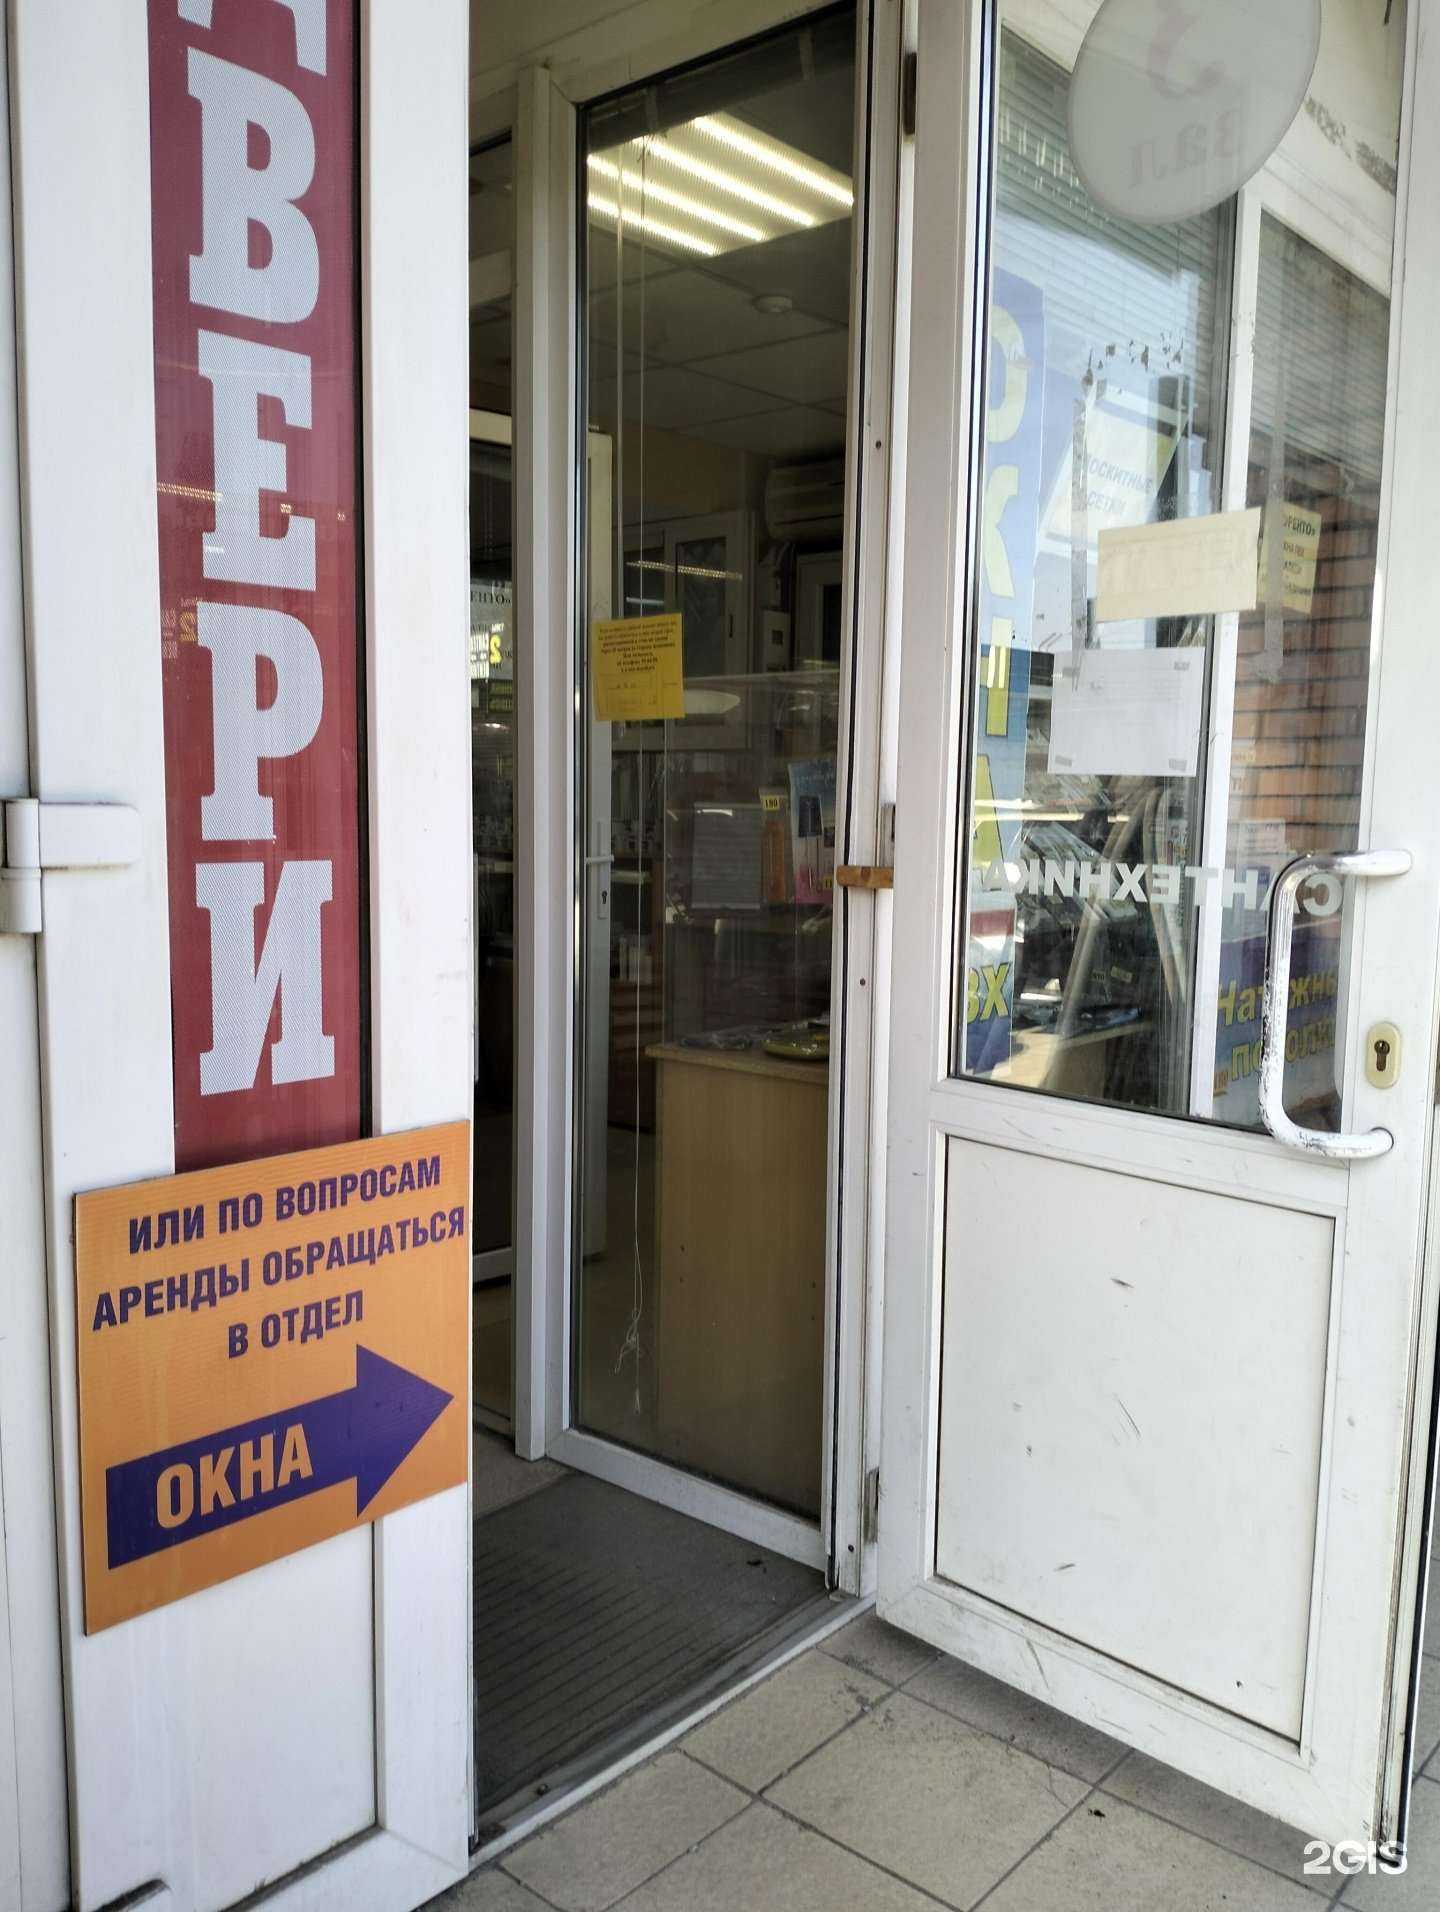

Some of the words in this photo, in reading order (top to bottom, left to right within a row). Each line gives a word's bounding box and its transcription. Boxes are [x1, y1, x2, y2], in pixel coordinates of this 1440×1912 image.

[1217, 970, 1338, 1026] Нажны
[1231, 1016, 1335, 1081] поолк
[129, 1203, 205, 1254] ИЛИ
[219, 1192, 263, 1229] ПО
[276, 1155, 442, 1222] ВОПРОСАМ
[93, 1258, 250, 1331] АРЕНДЫ
[262, 1205, 466, 1288] ОБРАЩАТЬСЯ
[228, 1323, 248, 1359] В
[261, 1290, 365, 1349] ОТДЕЛ
[156, 1421, 315, 1530] ОКНА
